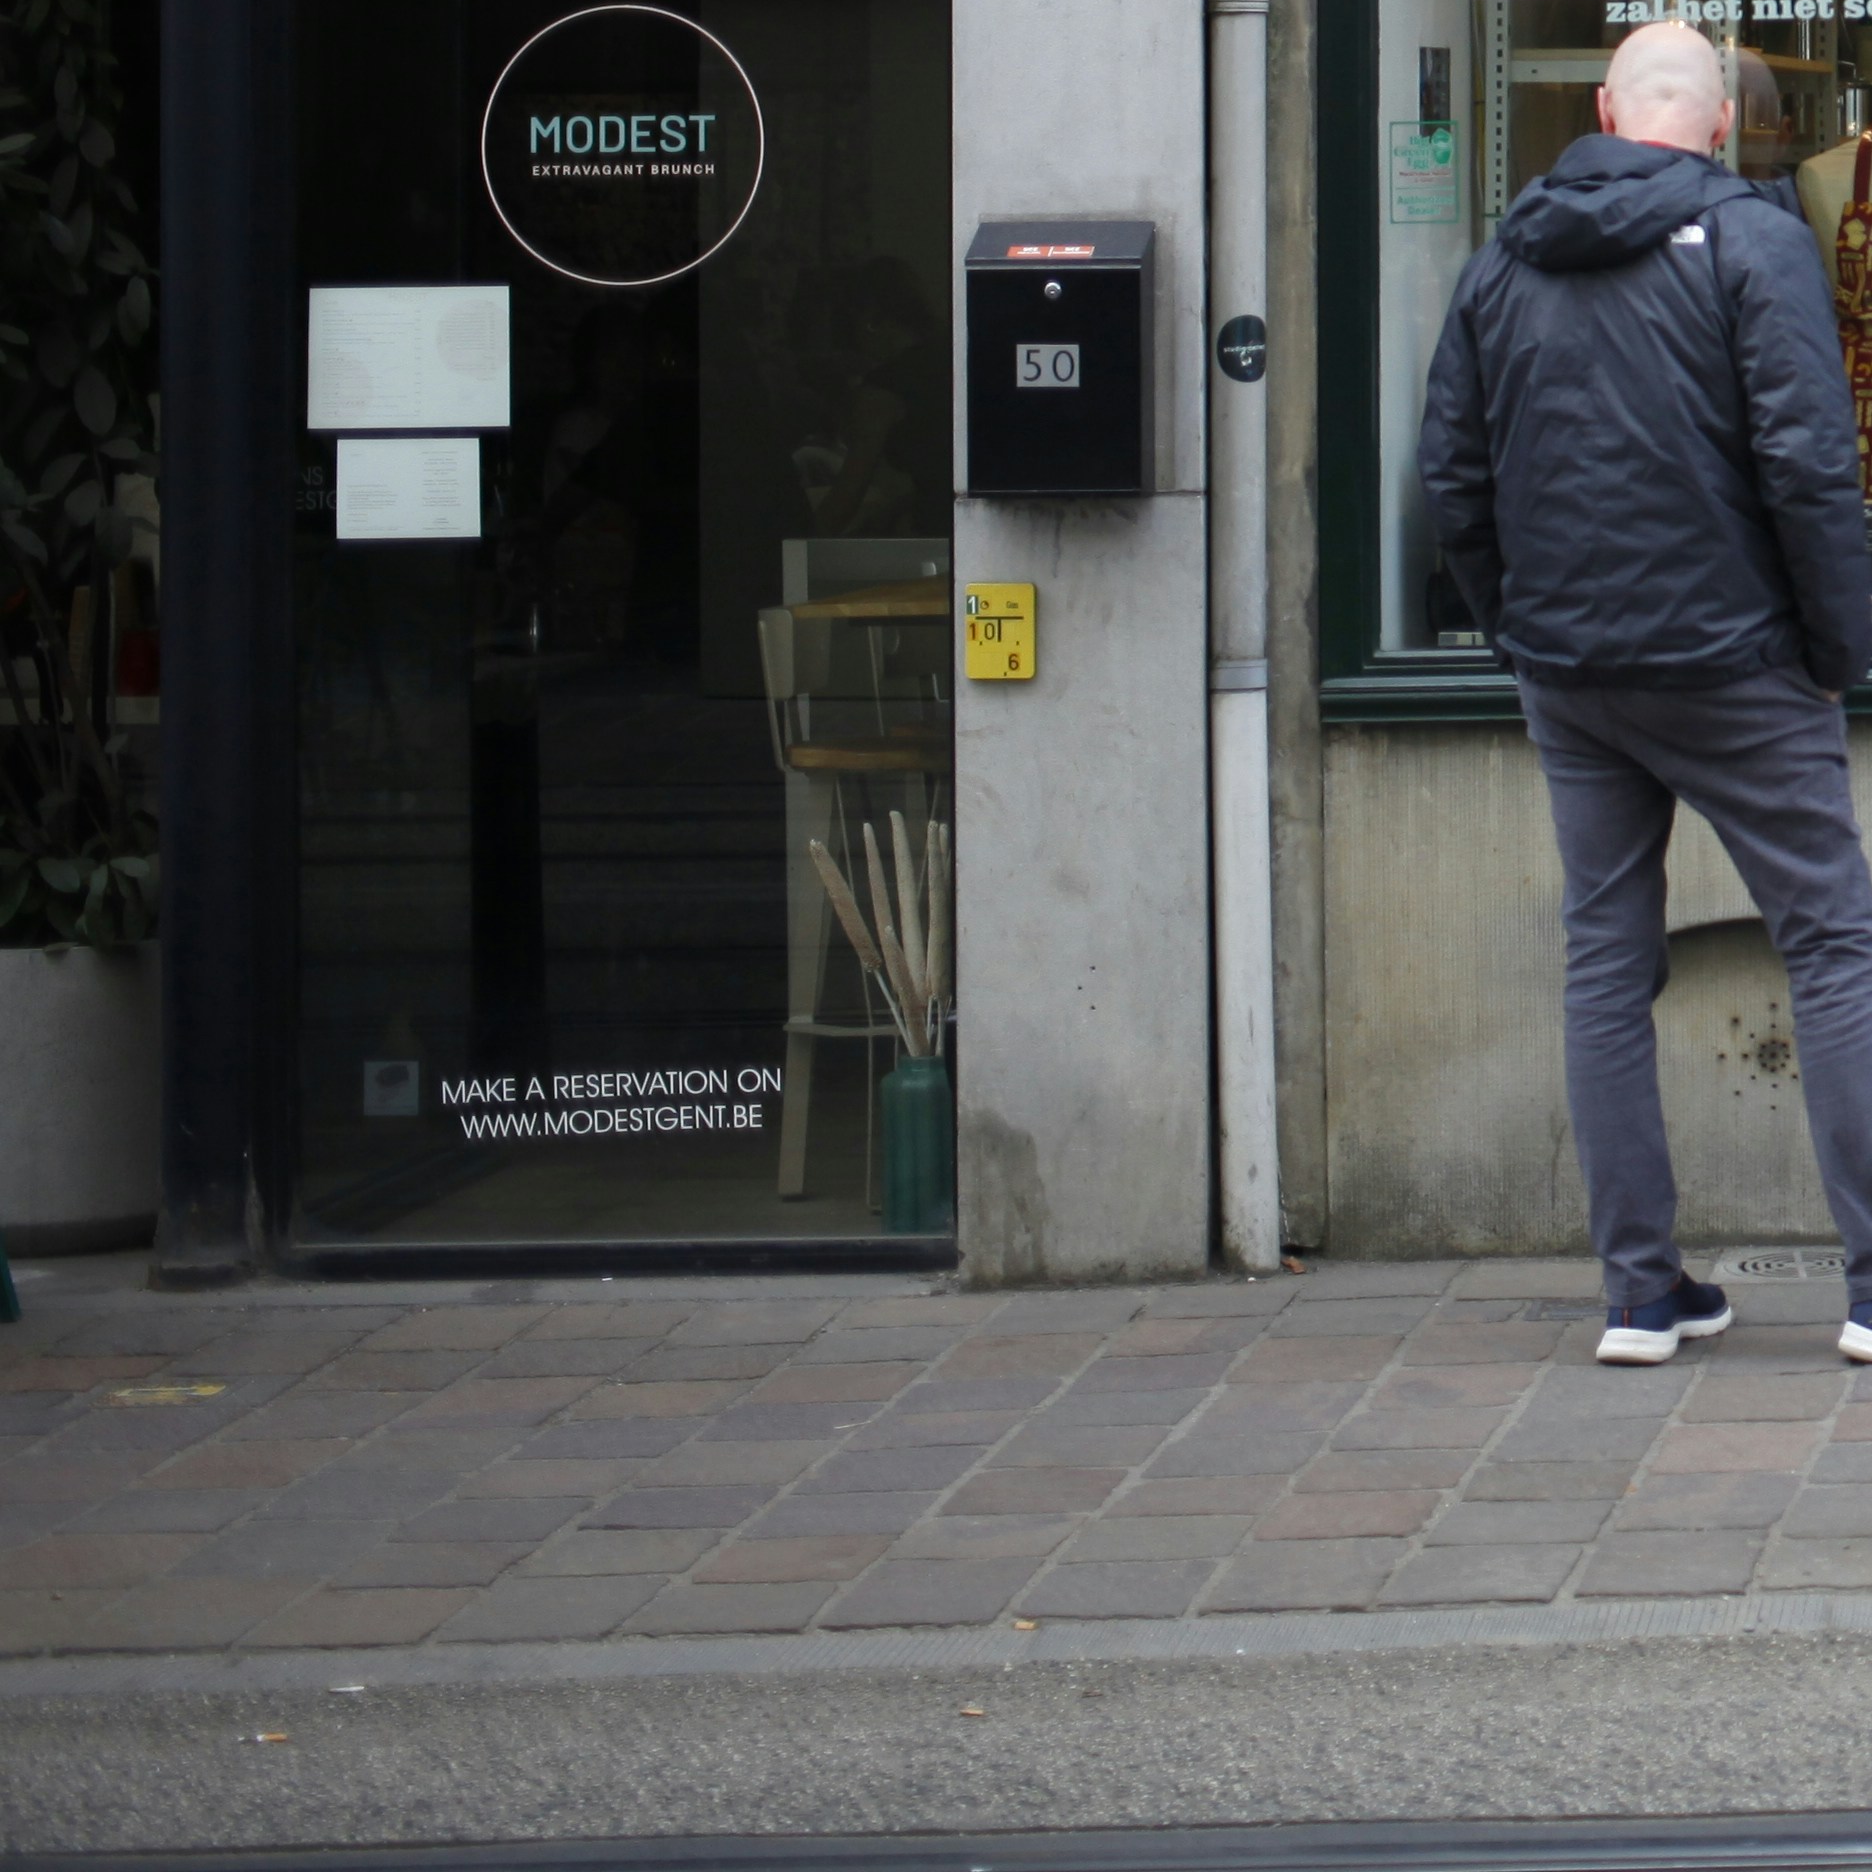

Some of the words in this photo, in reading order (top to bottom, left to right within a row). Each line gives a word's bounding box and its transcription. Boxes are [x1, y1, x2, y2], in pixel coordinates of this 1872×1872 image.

[530, 114, 715, 154] MODEST
[532, 165, 644, 176] EXTRAVAGANT
[651, 164, 715, 175] BRUNCH
[1023, 349, 1075, 382] 50
[967, 596, 976, 614] 1
[441, 1077, 516, 1105] MAKE
[525, 1076, 545, 1102] A
[553, 1069, 729, 1099] RESERVATION
[737, 1067, 782, 1093] ON
[461, 1103, 763, 1139] WWW.MODESTGENT.BE
